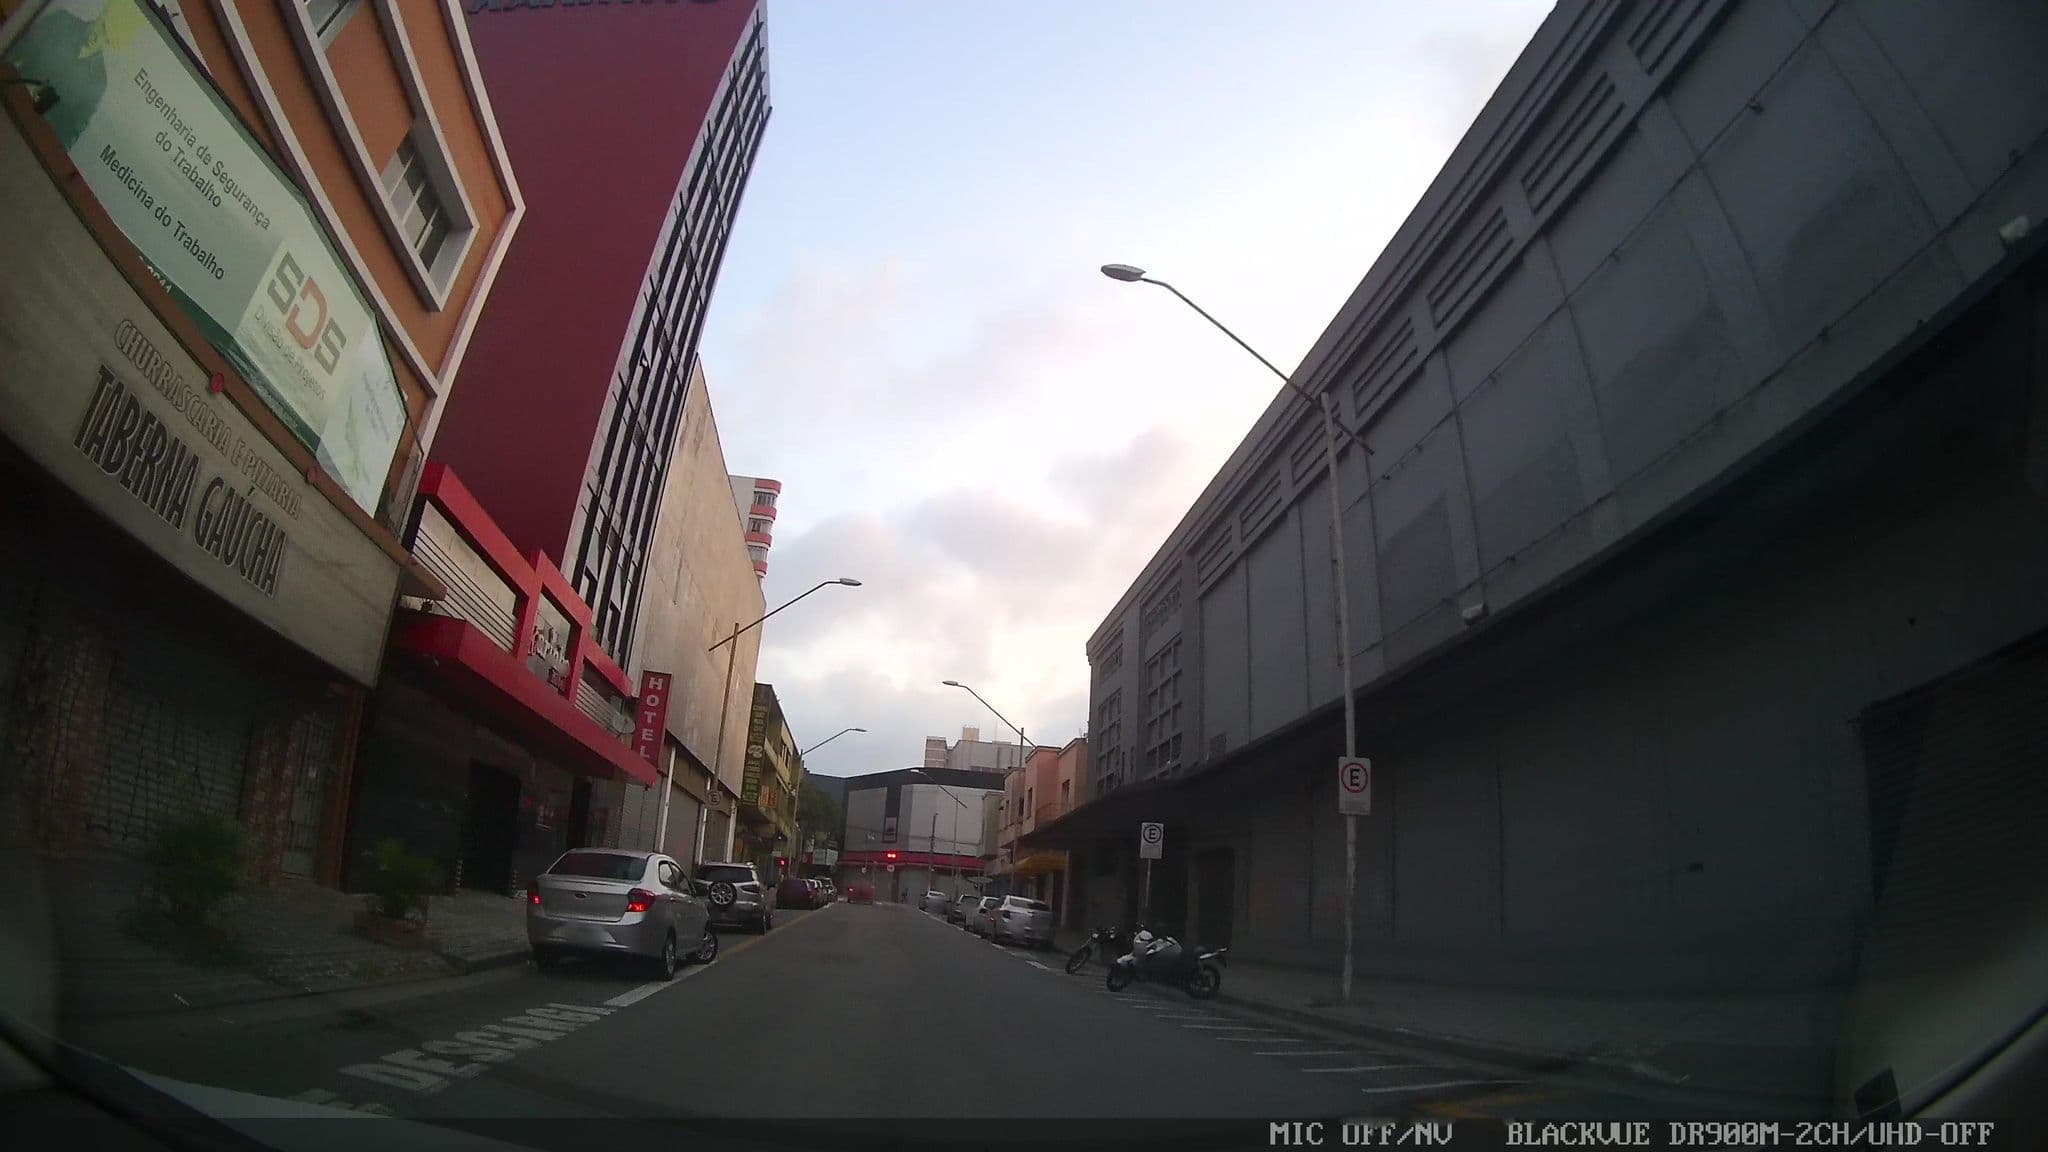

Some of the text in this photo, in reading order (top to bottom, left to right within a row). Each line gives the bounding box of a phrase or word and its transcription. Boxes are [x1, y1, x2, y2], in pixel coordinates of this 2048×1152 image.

[100, 143, 155, 210] Medicina
[154, 206, 172, 227] do
[173, 220, 225, 280] Trabalho
[133, 67, 272, 231] Engenharia de Segurança
[154, 131, 222, 208] do Trabalho
[113, 318, 233, 456] CHURRASCARIA
[231, 438, 246, 467] E
[73, 363, 201, 533] TABERNA
[194, 476, 288, 599] GAÚCHA
[639, 676, 664, 759] HOTEL
